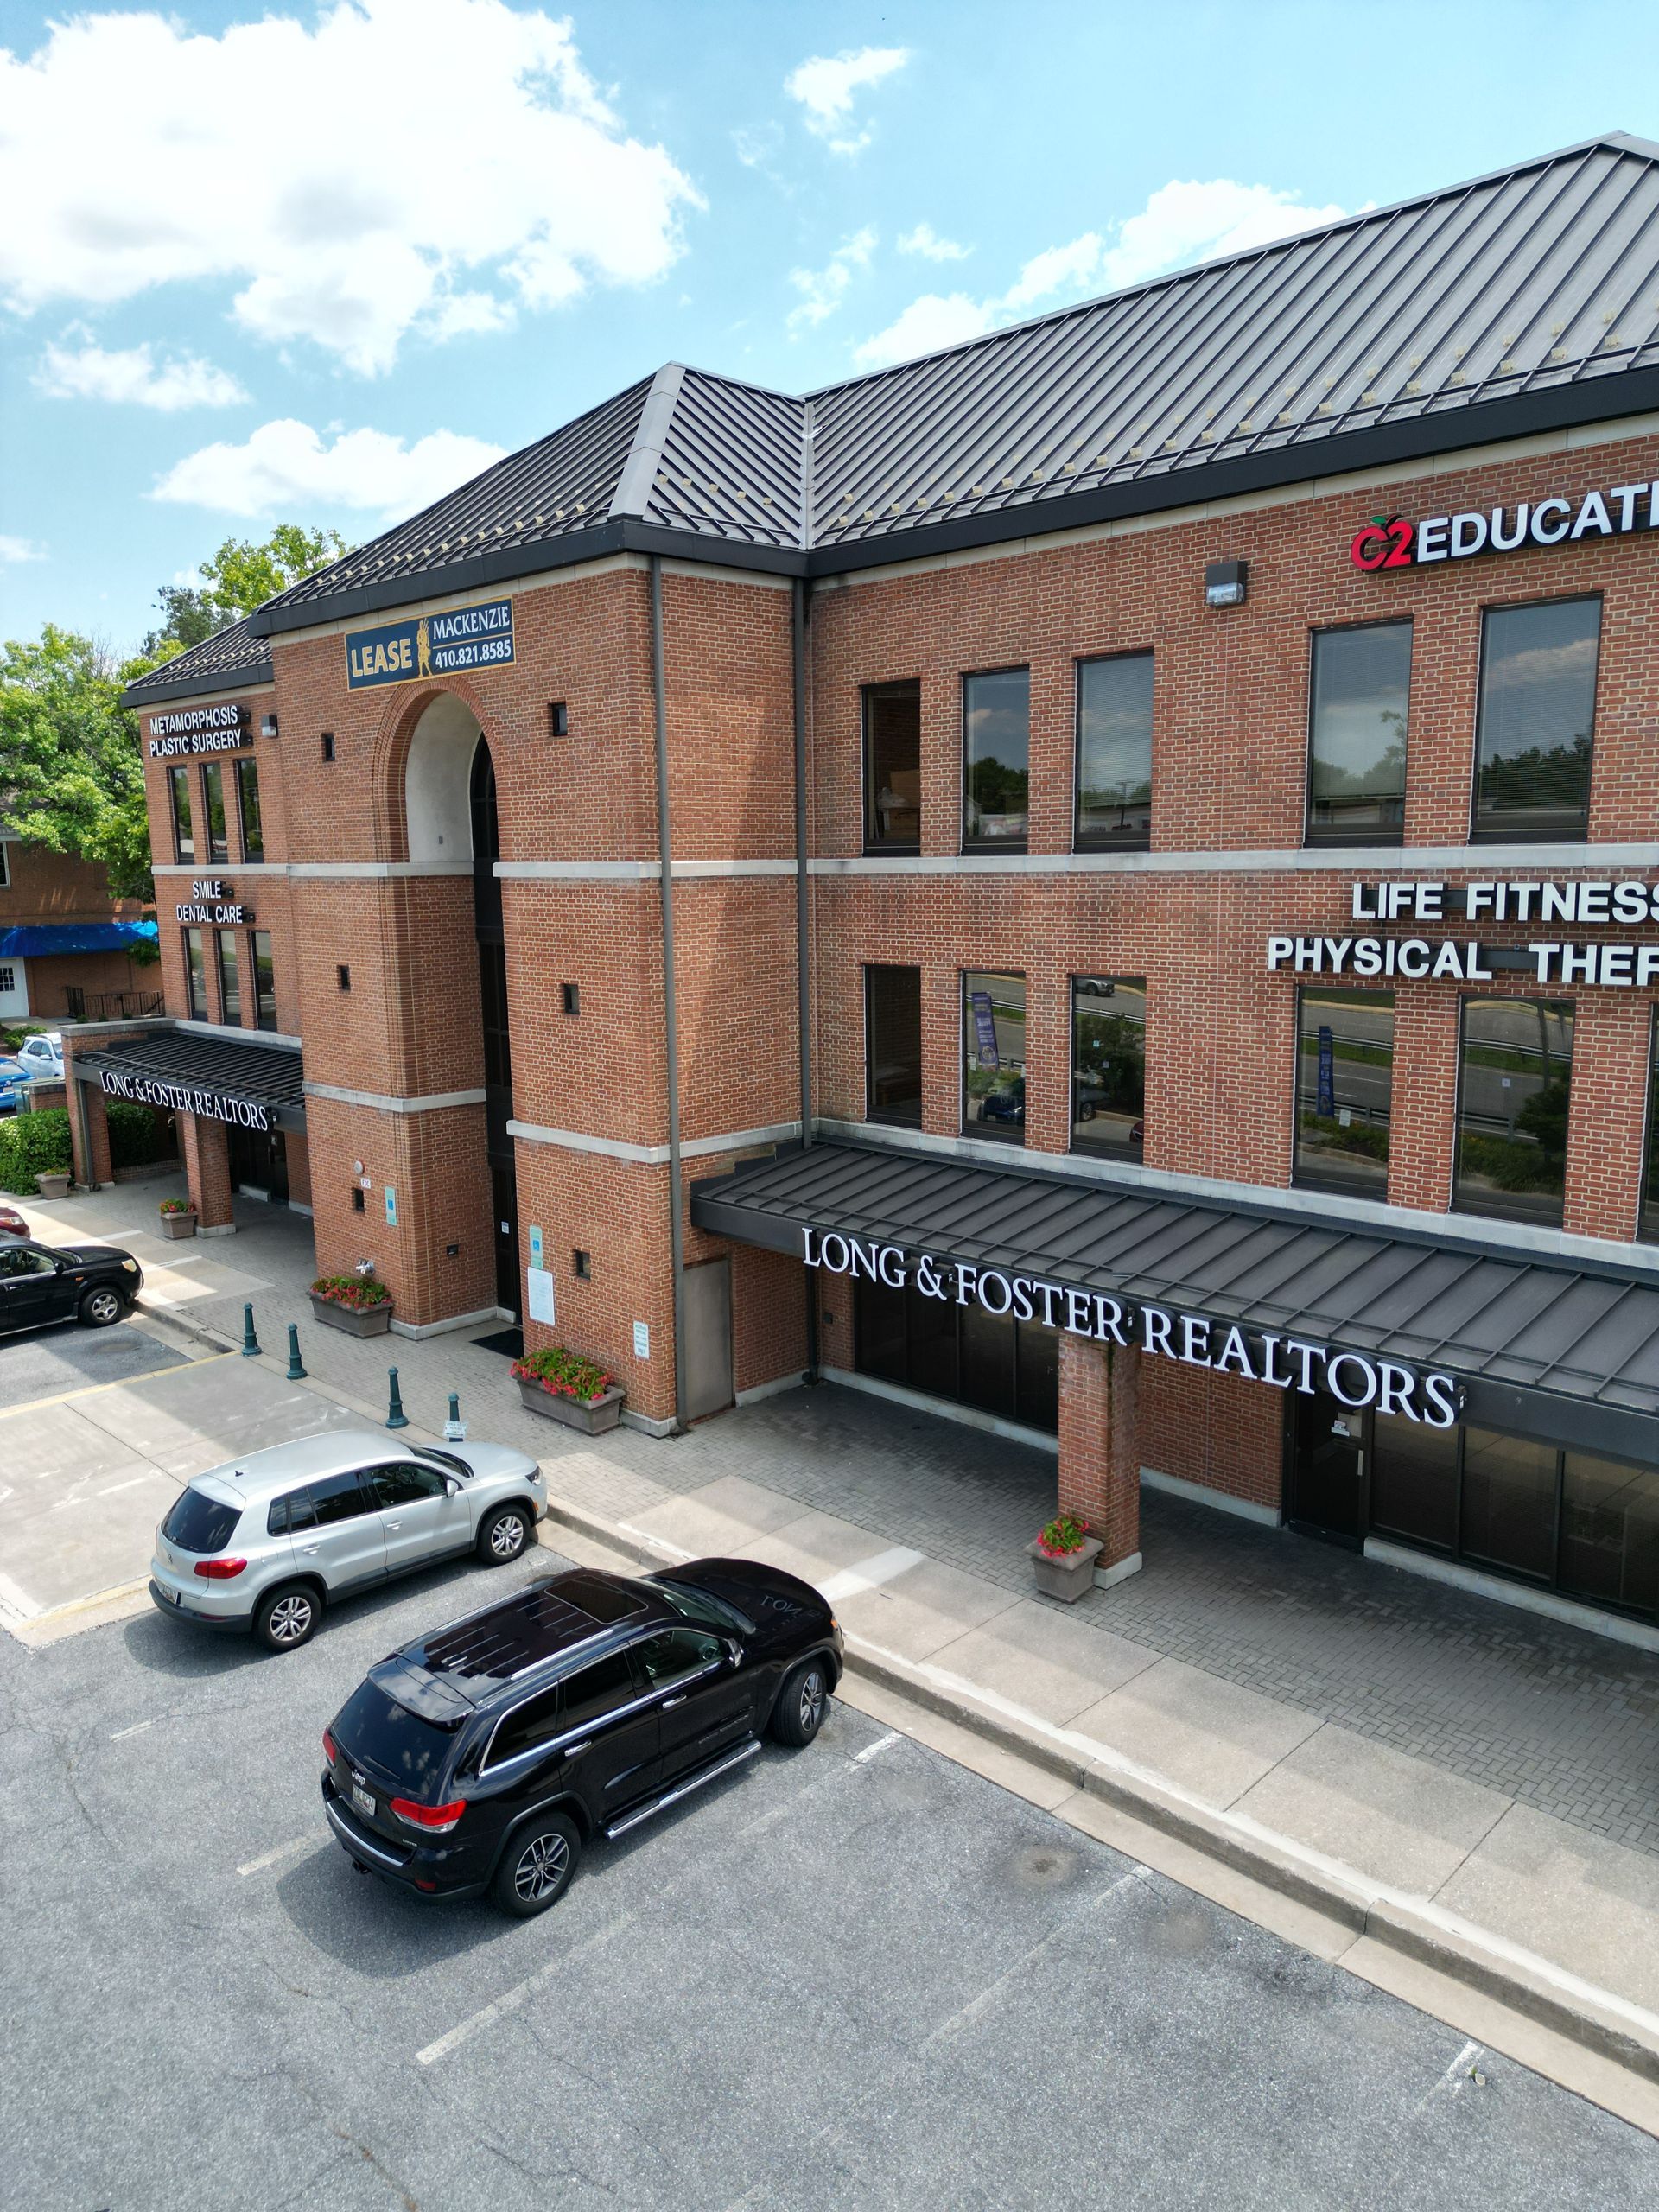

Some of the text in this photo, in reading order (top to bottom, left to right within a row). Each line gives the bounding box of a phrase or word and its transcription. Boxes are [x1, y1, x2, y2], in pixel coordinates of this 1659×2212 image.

[433, 606, 510, 640] MACKENZIE
[351, 638, 413, 677] LEASE
[435, 639, 512, 669] 410.821.8585
[149, 705, 238, 735] METAMORPHOSIS
[149, 728, 241, 757] PLASTIC SURGERY
[193, 880, 222, 899] SMILE
[1352, 882, 1444, 919] LIFE
[176, 905, 242, 924] DENTAL CARE
[1268, 937, 1493, 981] PHYSICAL
[99, 1071, 269, 1132] LONG & FOSTER REALTORS
[802, 1227, 1455, 1428] LONG & FOSTER REALTORS
[351, 1769, 366, 1786] Jeep
